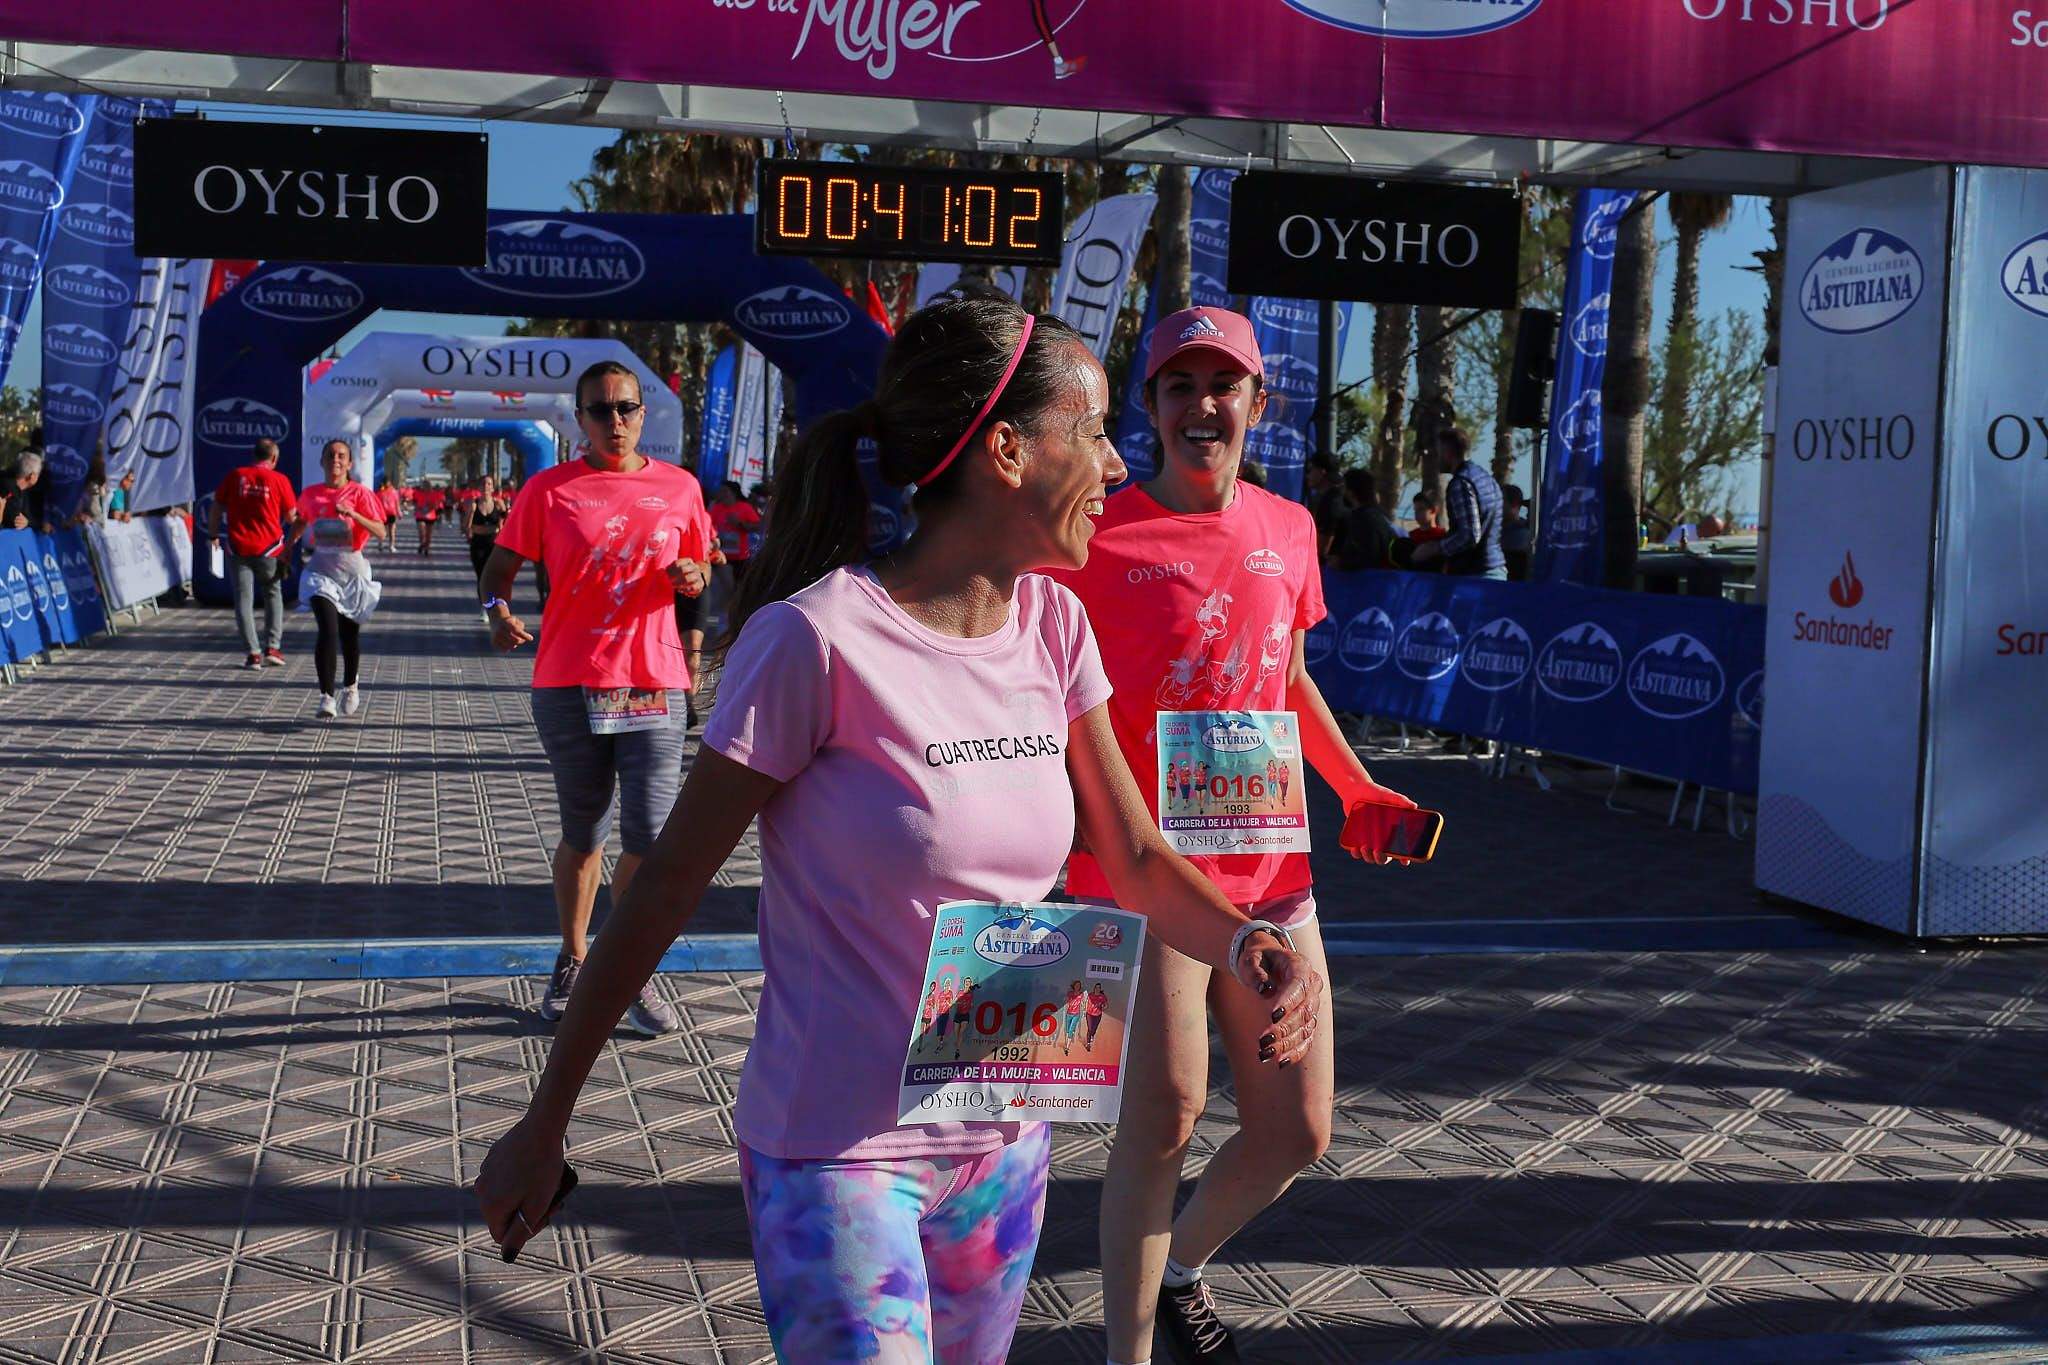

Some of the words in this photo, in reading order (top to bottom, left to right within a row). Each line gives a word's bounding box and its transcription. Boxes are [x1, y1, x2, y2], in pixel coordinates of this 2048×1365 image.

[1683, 0, 1889, 31] SHO
[194, 164, 439, 223] OYSHO
[1278, 214, 1479, 268] OYSHO
[2013, 255, 2048, 297] A
[251, 284, 353, 309] ASTURIANA
[1807, 272, 1913, 312] ASTURIANA
[749, 306, 842, 326] ASTURIANA
[1179, 328, 1225, 339] adidas
[422, 345, 572, 380] OYSHO
[331, 376, 379, 388] OYSHO
[201, 415, 282, 436] ASTURIANA
[1793, 414, 1914, 461] OYSHO
[1127, 561, 1195, 584] OYSHO
[1793, 611, 1893, 650] Santander
[1165, 727, 1191, 736] SUMA
[1206, 727, 1261, 745] ASTURIANA
[925, 734, 1060, 768] CUATRECASAS
[1210, 774, 1265, 798] 016
[1223, 804, 1250, 815] 1993
[1168, 819, 1206, 828] CARRERA
[1208, 819, 1218, 828] DE
[1220, 818, 1231, 827] LA
[1232, 818, 1260, 827] MUJER
[1266, 817, 1298, 826] VALENCIA
[1177, 835, 1225, 847] OYSHO
[1254, 835, 1294, 845] Santander
[940, 925, 964, 939] SUMA
[1095, 923, 1119, 940] 20
[980, 932, 1063, 956] ASTURIANA
[975, 1000, 1058, 1037] 016
[991, 1046, 1030, 1061] 1992
[913, 1065, 961, 1081] CARRERA
[963, 1066, 980, 1079] DE
[982, 1066, 997, 1079] LA
[1001, 1067, 1041, 1081] MUJER
[1052, 1067, 1106, 1081] VALENCIA
[920, 1090, 985, 1110] OYSHO
[1028, 1094, 1094, 1109] Santander
